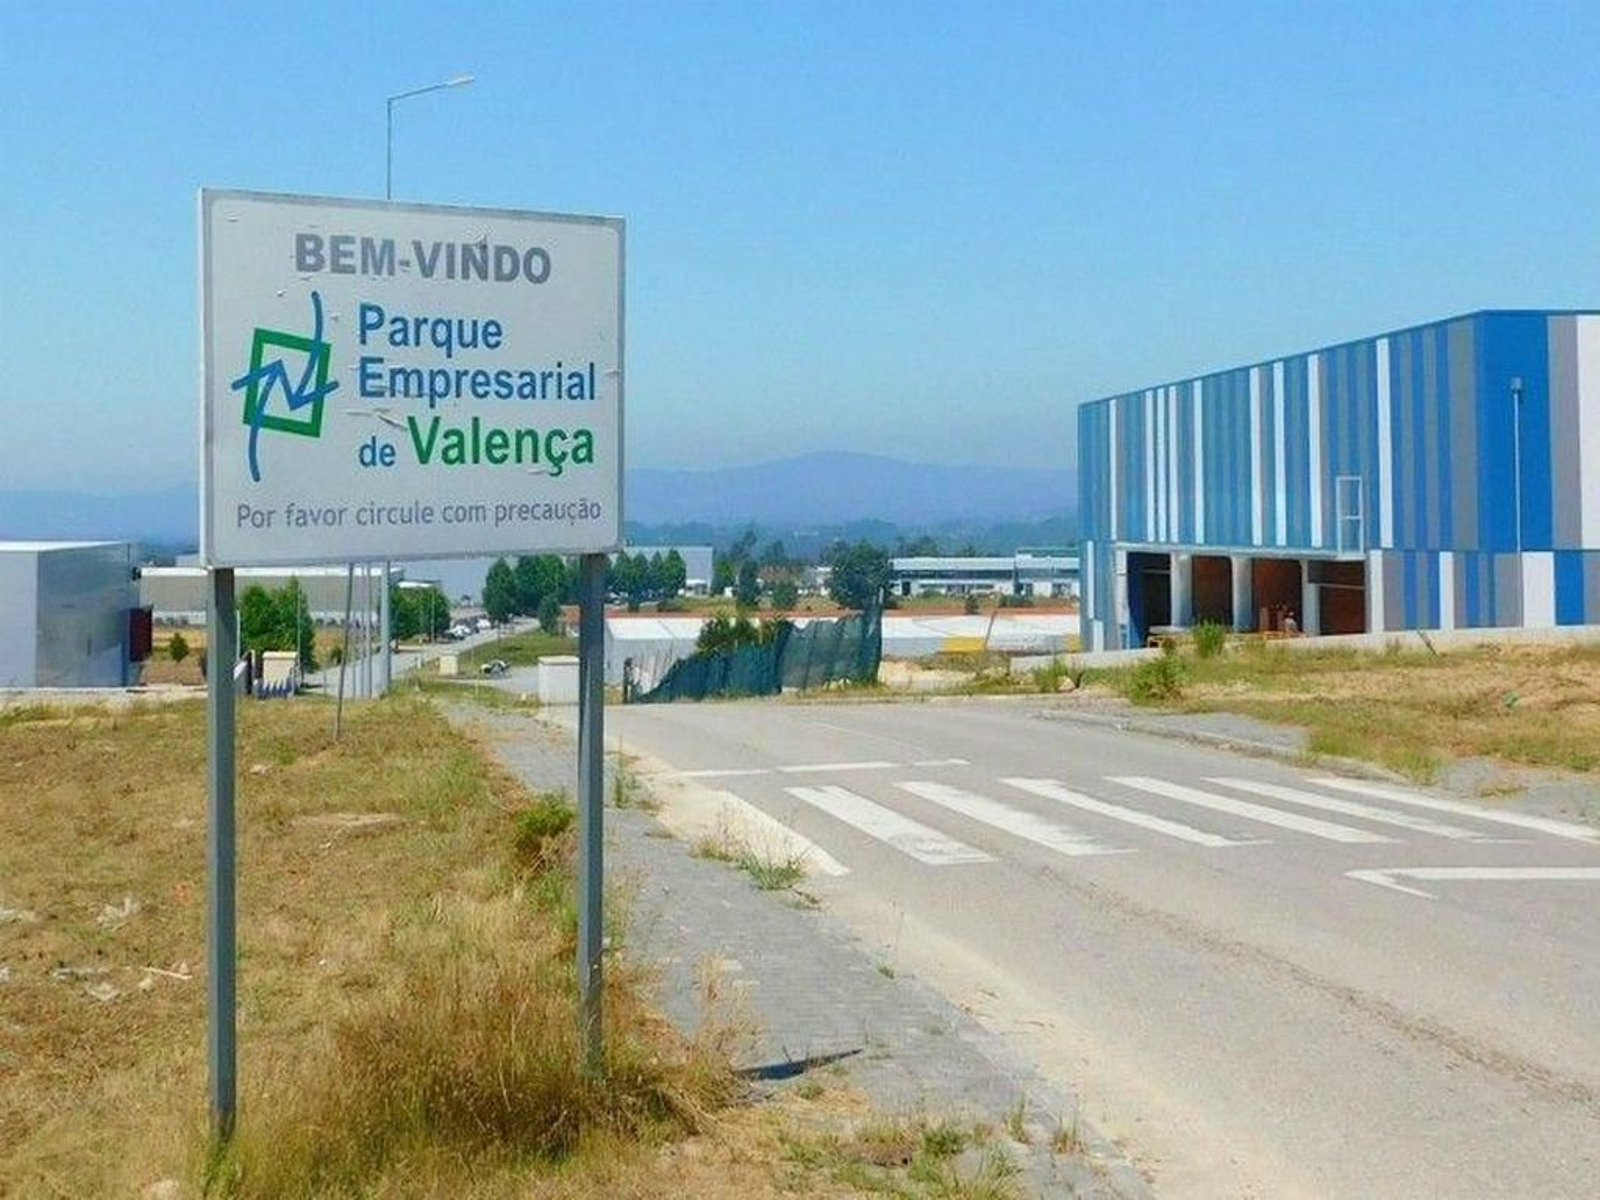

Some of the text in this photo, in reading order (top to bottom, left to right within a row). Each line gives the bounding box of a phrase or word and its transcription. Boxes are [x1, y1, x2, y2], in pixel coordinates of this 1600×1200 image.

[295, 232, 552, 285] BEM-VINDO
[359, 302, 503, 357] Parque
[359, 356, 596, 408] Empresarial
[359, 415, 595, 476] de Valença
[237, 497, 602, 528] Por favor circule com precaução
